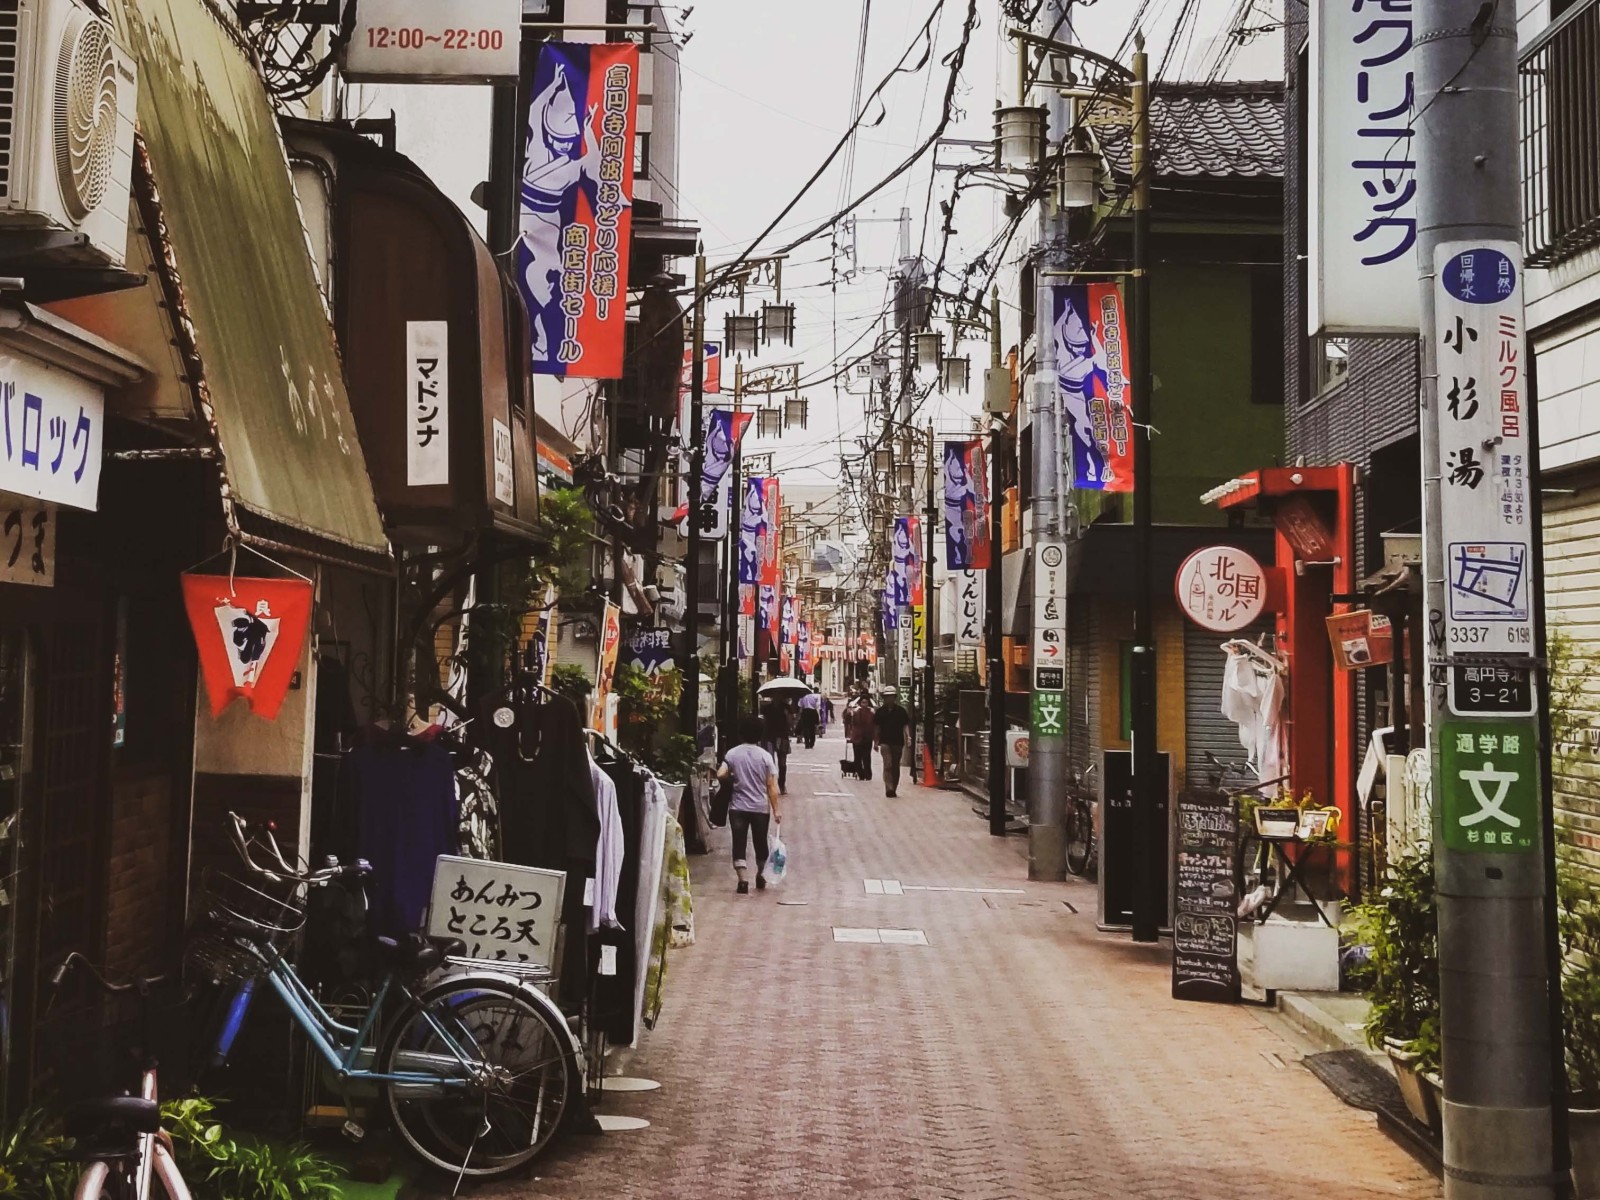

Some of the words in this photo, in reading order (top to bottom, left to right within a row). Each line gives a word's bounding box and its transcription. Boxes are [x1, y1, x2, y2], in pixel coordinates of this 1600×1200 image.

[591, 64, 630, 320] 高円寺阿波おどり応援!
[557, 223, 589, 362] 商店街セール
[1498, 258, 1511, 294] 自然
[416, 358, 439, 447] マドンナ
[1443, 315, 1484, 491] 小杉湯
[1498, 315, 1519, 438] ミルク風呂
[0, 381, 91, 484] バロック
[1451, 627, 1489, 643] 3337
[1508, 627, 1530, 643] 6198
[1469, 687, 1519, 703] 3-21
[1456, 733, 1520, 754] 通学路
[1459, 761, 1521, 828] 文
[1467, 829, 1513, 845] 杉並区
[450, 875, 542, 910] あんみつ
[447, 906, 540, 946] ところ天
